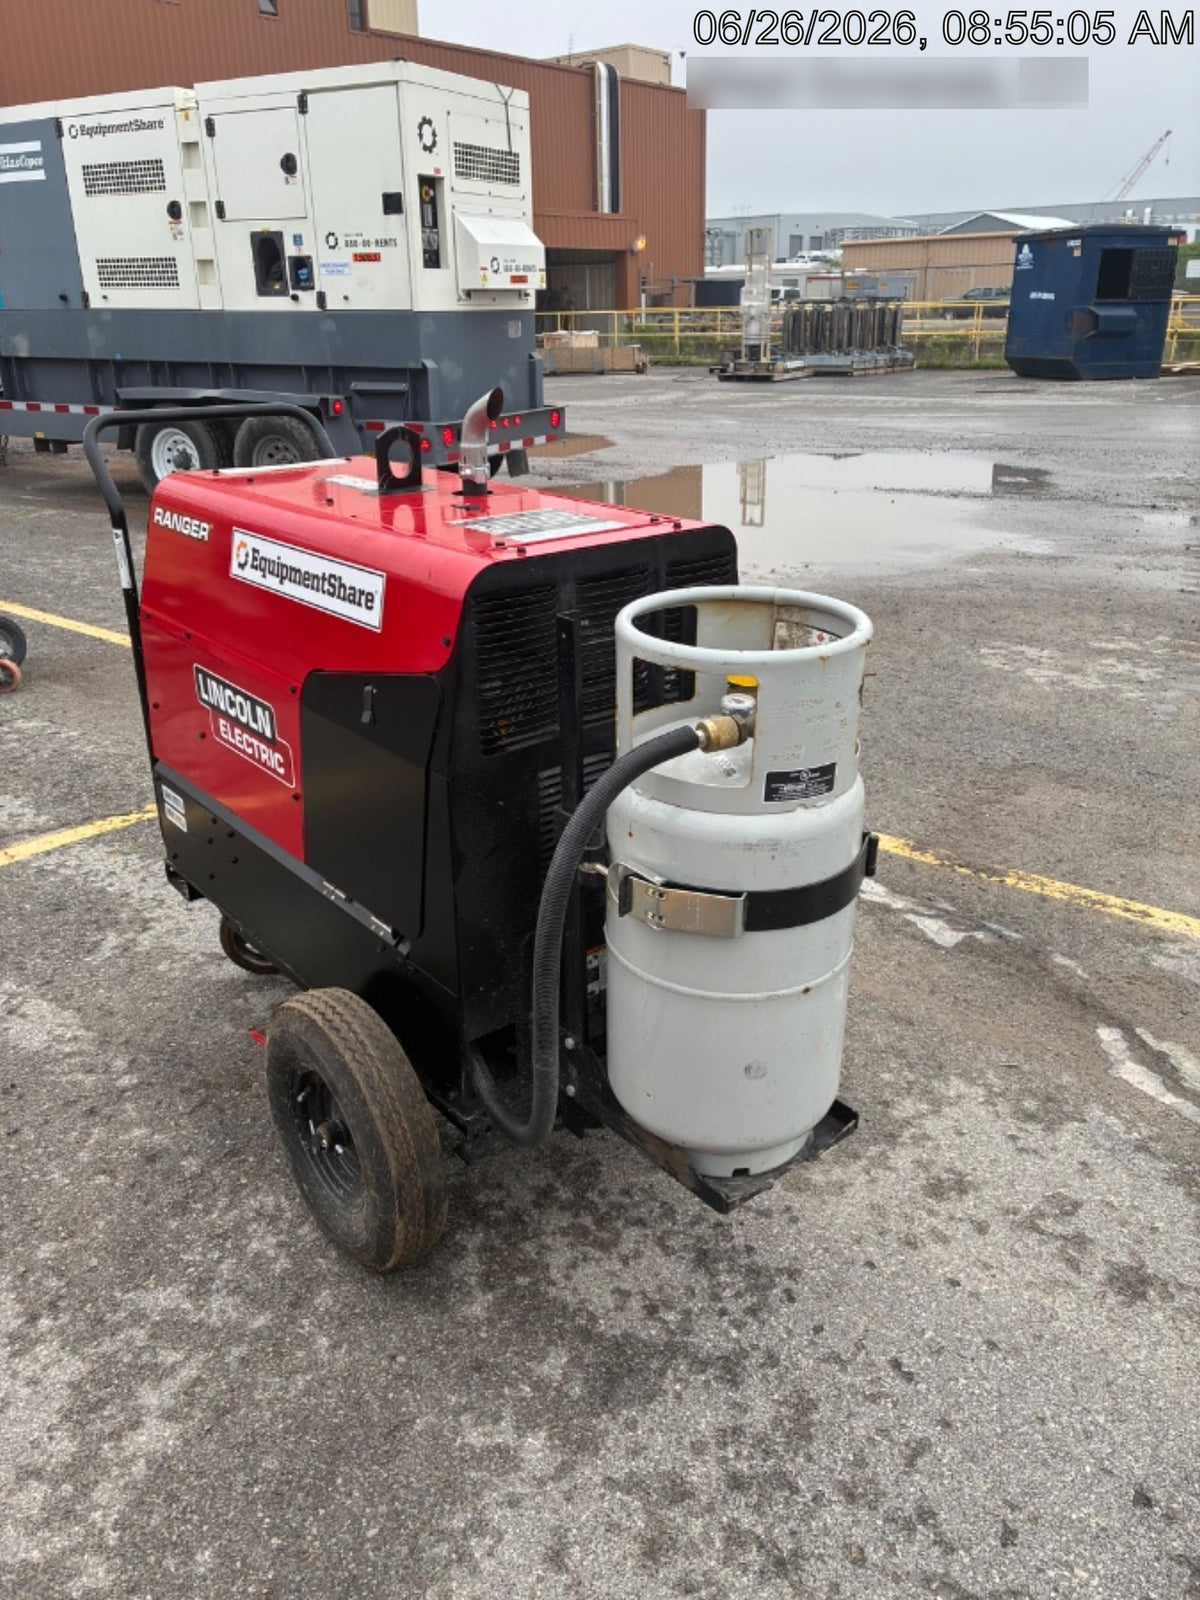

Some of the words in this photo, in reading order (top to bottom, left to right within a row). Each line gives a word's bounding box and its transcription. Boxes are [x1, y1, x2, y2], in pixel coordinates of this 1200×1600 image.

[80, 118, 164, 138] EquipmentShare
[154, 507, 210, 541] RANGER
[250, 548, 375, 611] EquipmentShare
[199, 673, 272, 739] LINCOLN
[219, 718, 285, 775] ELECTRIC
